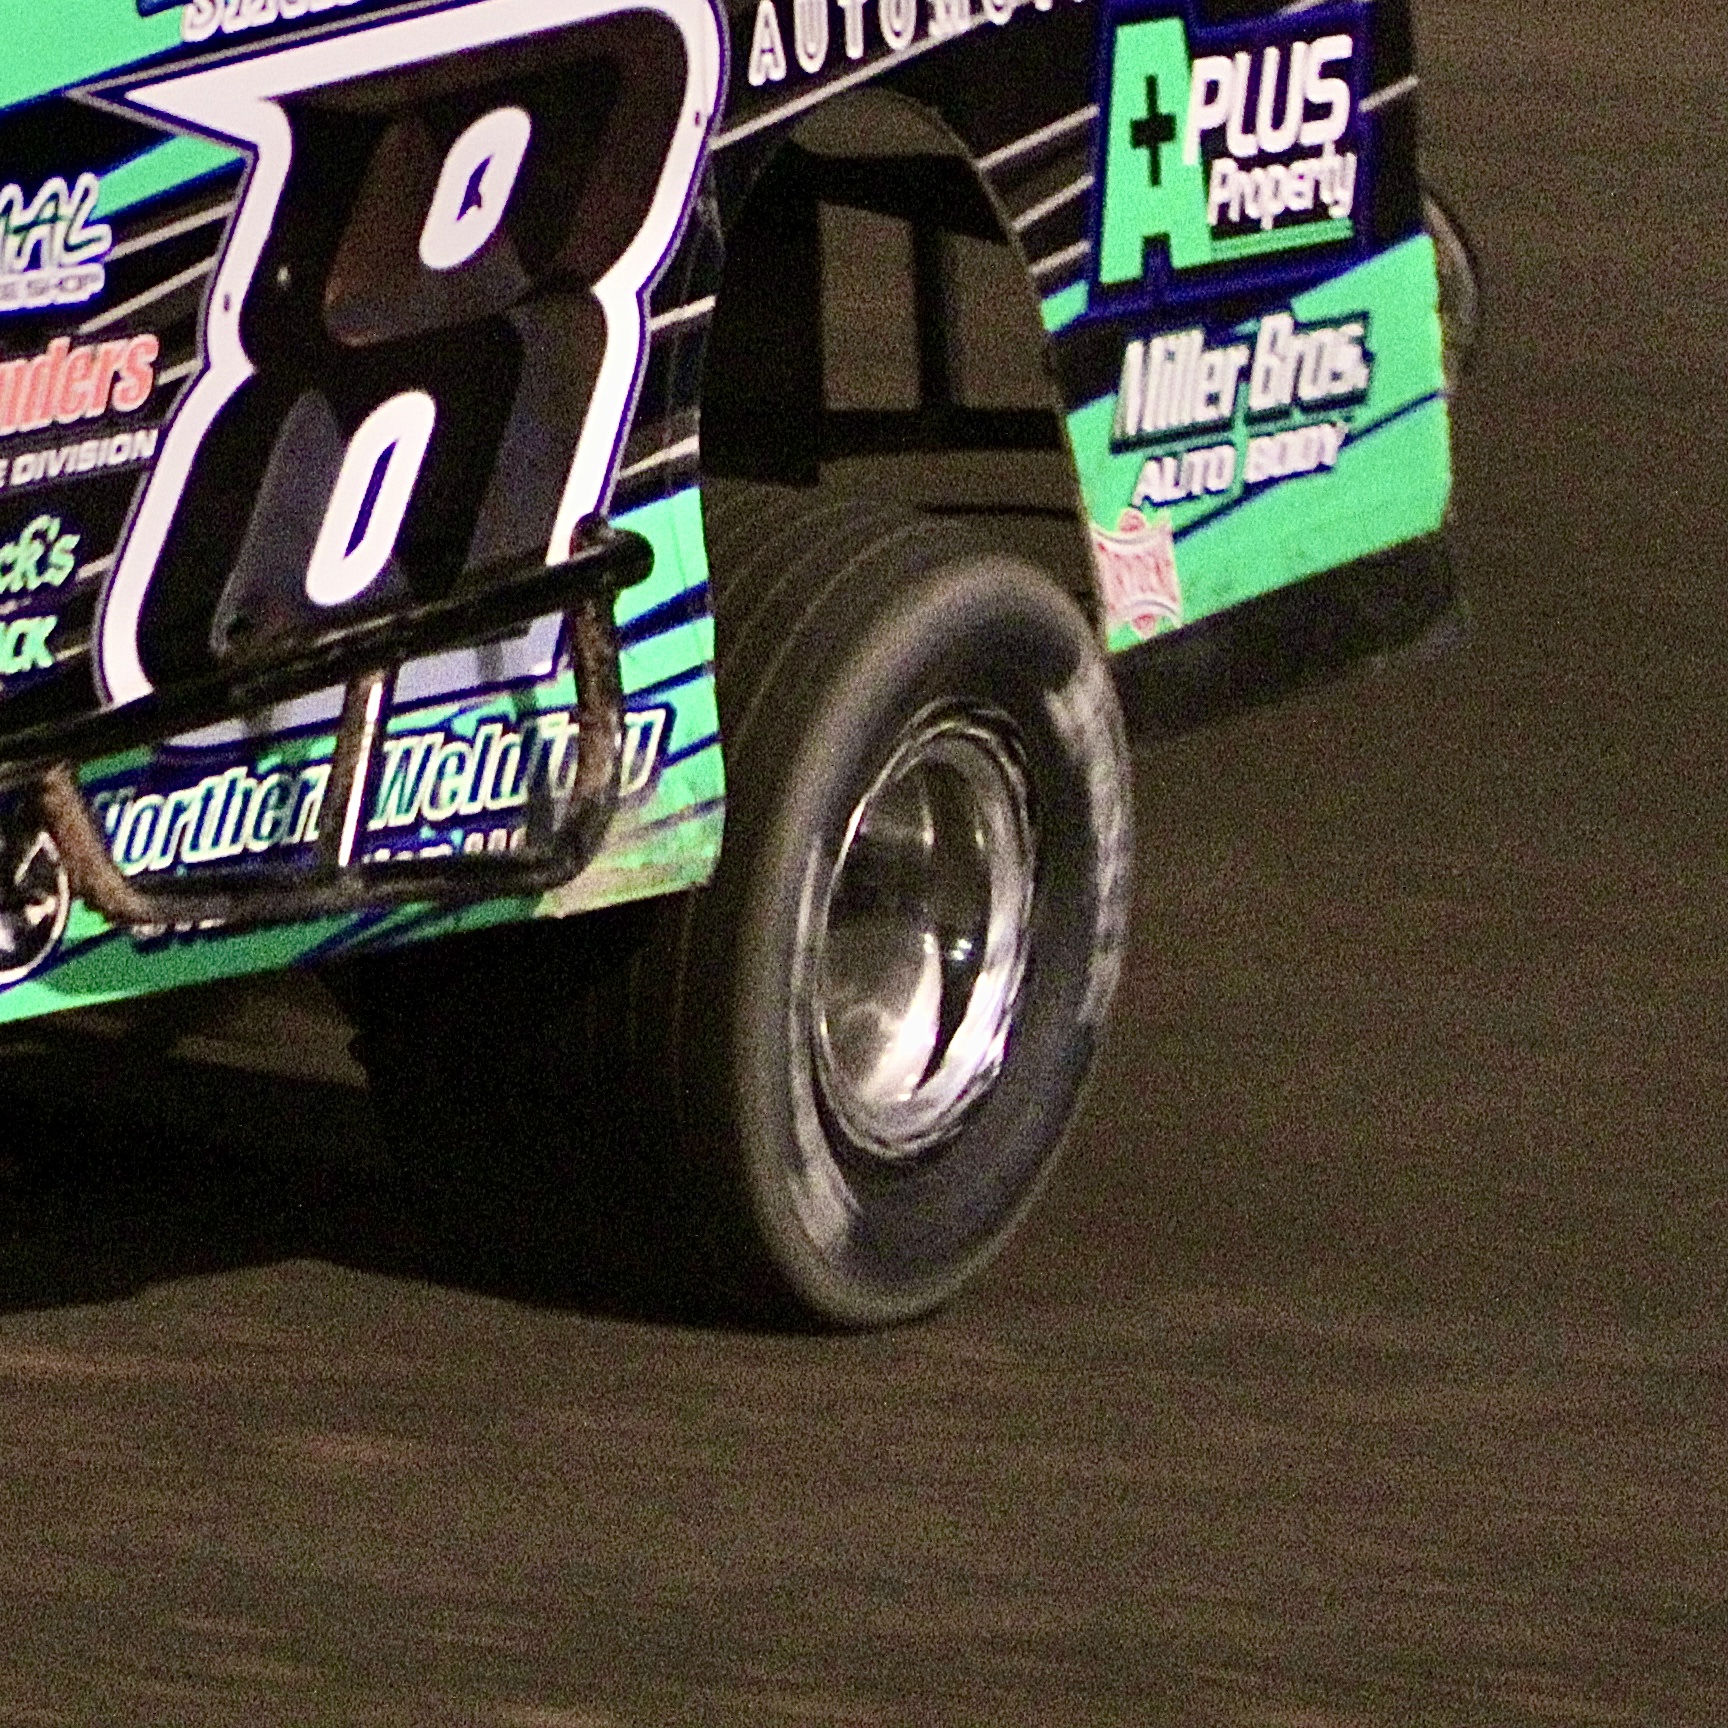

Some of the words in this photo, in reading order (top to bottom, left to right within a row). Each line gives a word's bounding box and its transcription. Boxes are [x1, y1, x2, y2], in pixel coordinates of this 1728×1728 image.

[1184, 33, 1353, 166] PLUS
[1207, 138, 1359, 229] Property
[1114, 328, 1250, 442] Miller
[9, 428, 160, 488] DIVISION
[1131, 444, 1236, 507] AUTO
[1244, 421, 1348, 484] BODY
